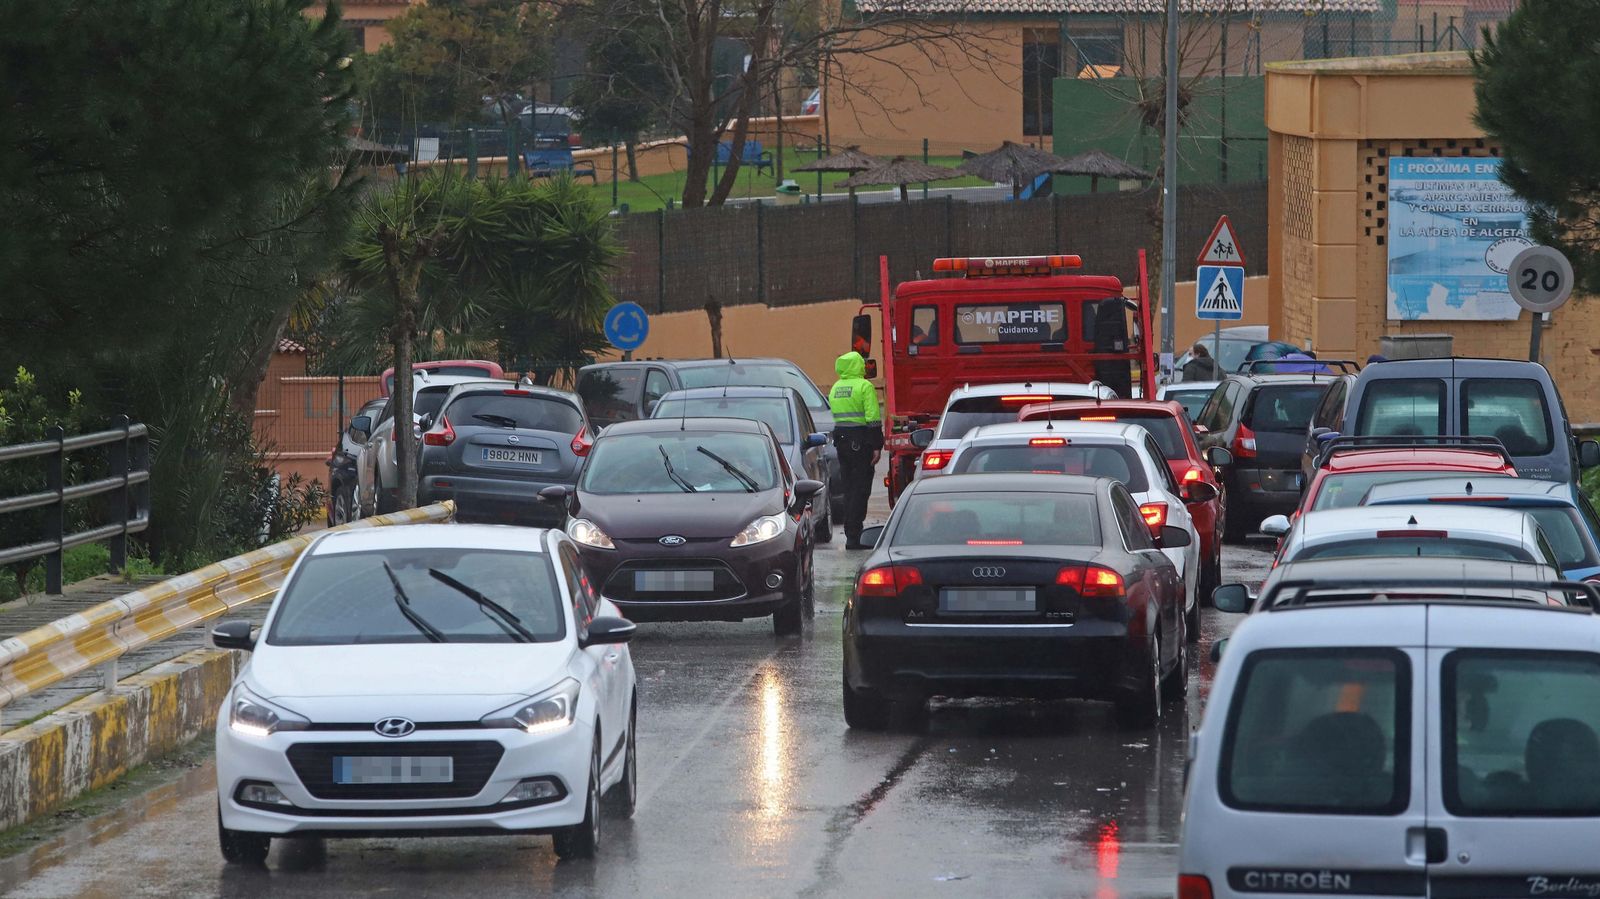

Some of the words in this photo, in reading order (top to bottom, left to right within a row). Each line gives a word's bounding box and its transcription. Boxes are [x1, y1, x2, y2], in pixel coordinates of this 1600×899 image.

[1407, 163, 1470, 174] PROXIMA
[1414, 181, 1465, 191] ULTIMAS
[1408, 203, 1417, 213] Y
[1419, 203, 1471, 213] GARAJES
[1462, 217, 1478, 226] EN
[1399, 228, 1417, 237] LA
[1420, 228, 1457, 237] ALDEA
[1460, 228, 1476, 237] DE
[995, 258, 1030, 267] MAPFRE
[1521, 268, 1560, 292] 20
[975, 309, 1059, 325] MAPFRE
[987, 326, 996, 334] Te
[998, 325, 1038, 334] Cuidamos
[489, 450, 516, 461] 9802
[518, 452, 538, 462] HNN
[907, 609, 924, 618] A4
[1244, 869, 1351, 889] CITROËN
